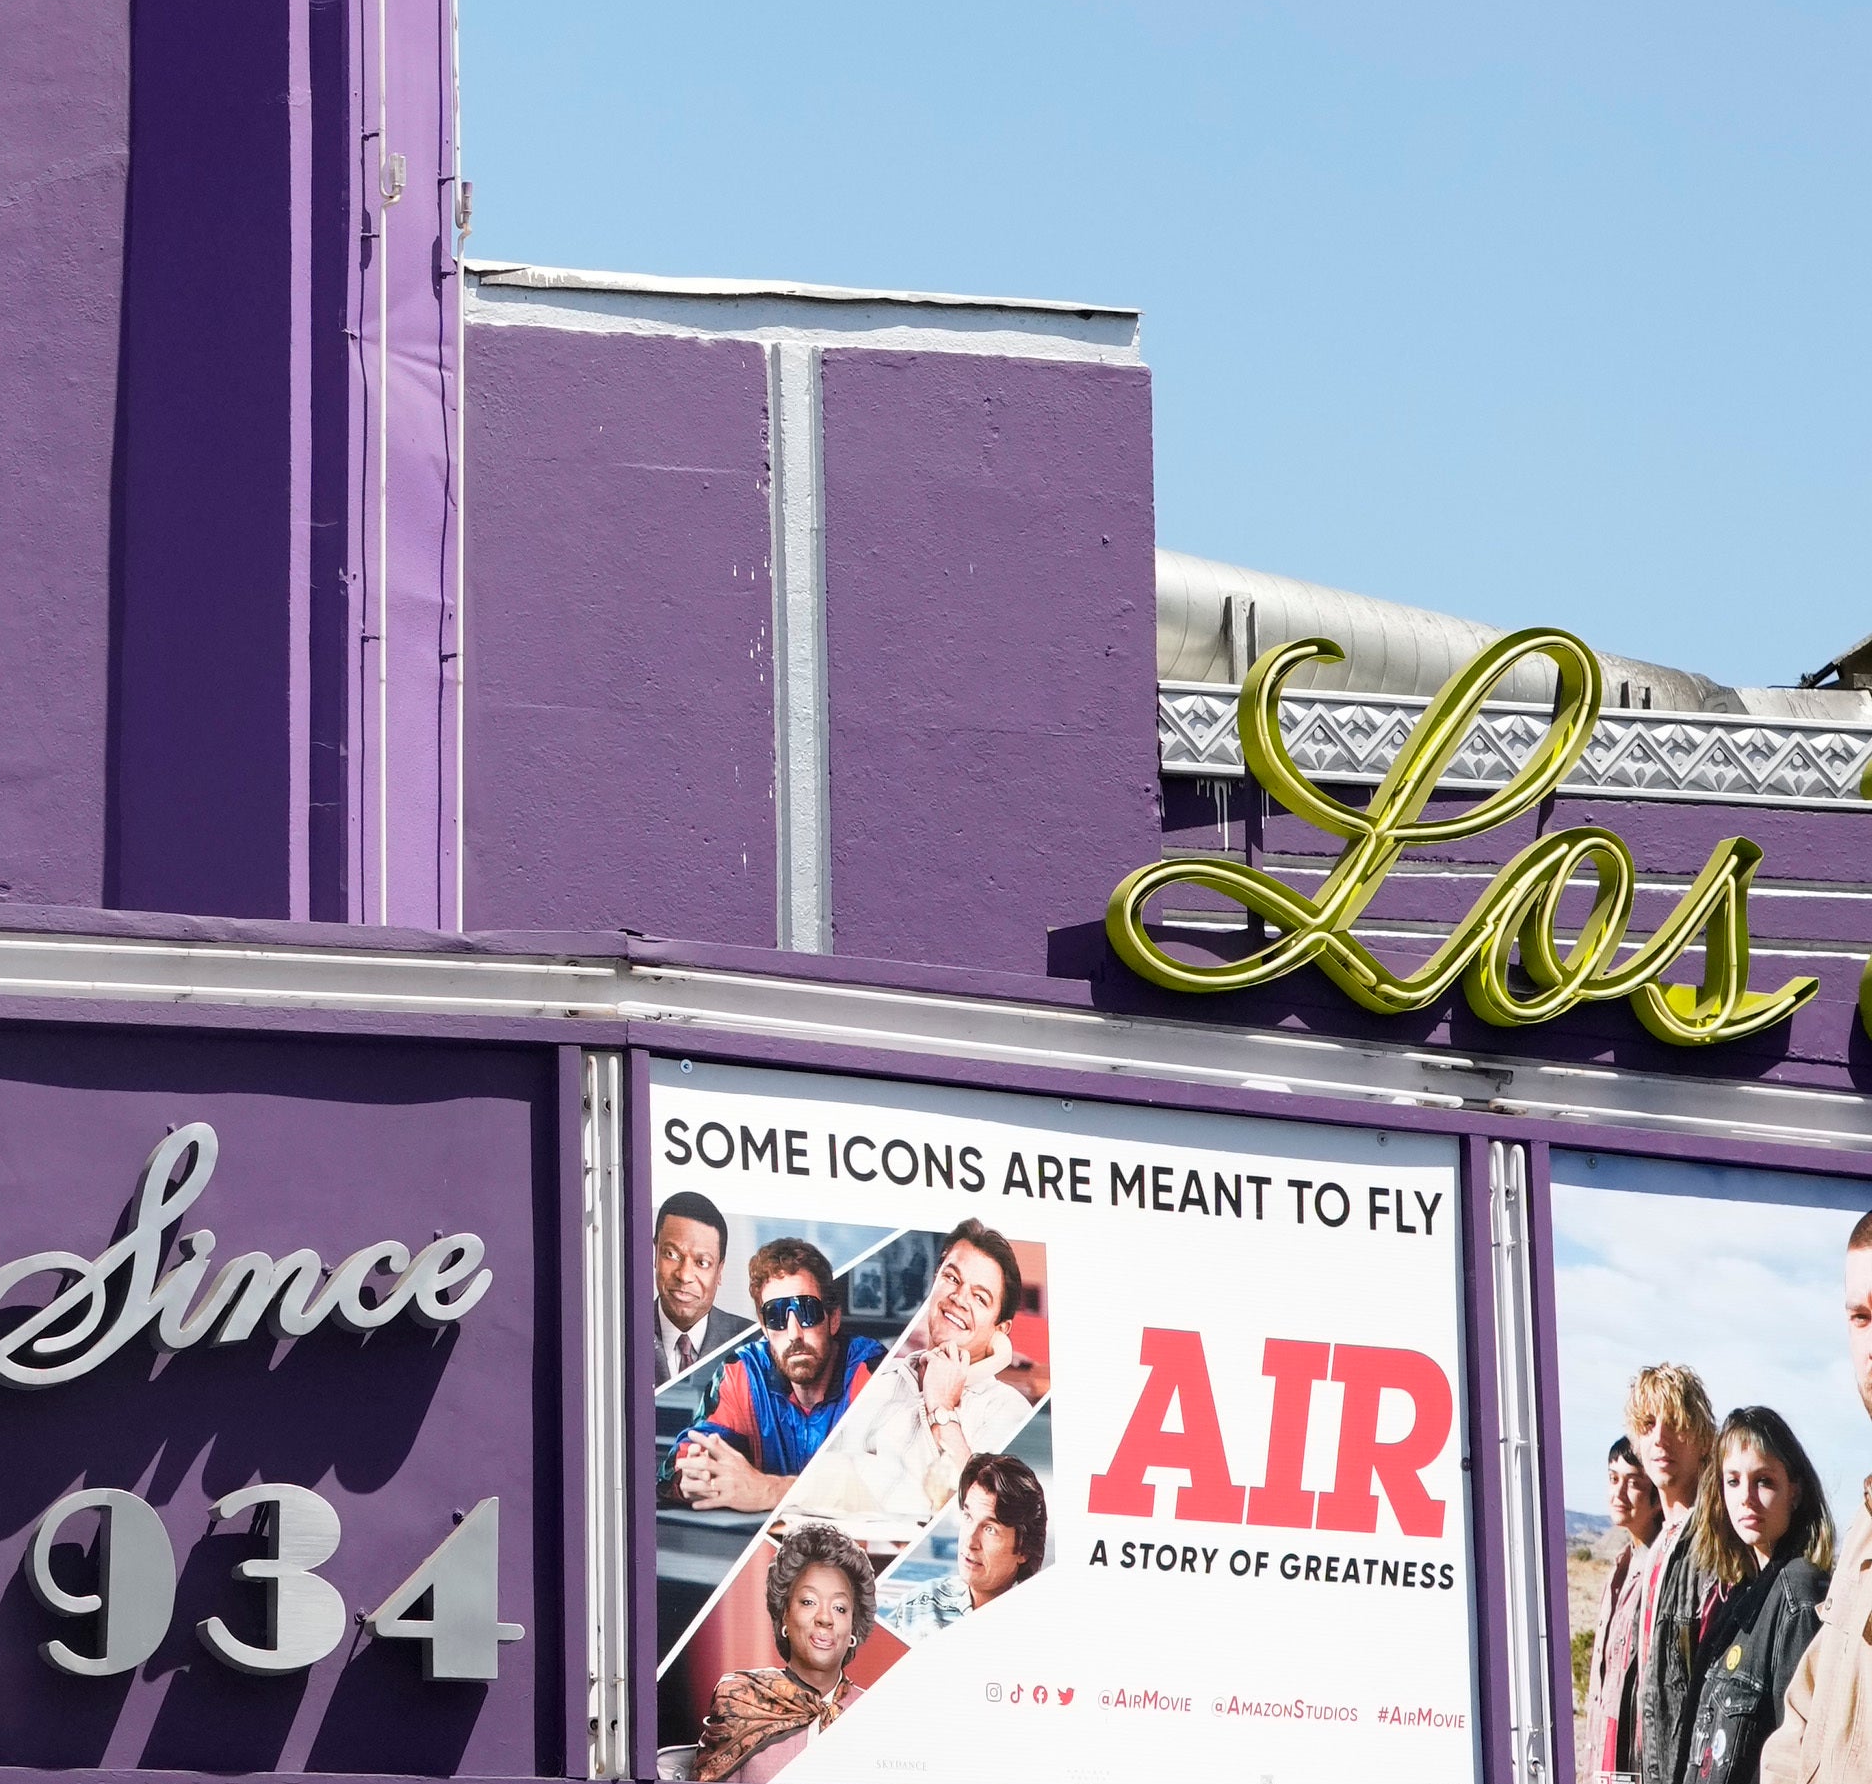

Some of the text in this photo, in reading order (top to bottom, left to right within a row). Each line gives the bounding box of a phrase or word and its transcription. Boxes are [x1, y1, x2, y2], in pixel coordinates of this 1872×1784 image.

[1105, 627, 1819, 1047] Los
[663, 1117, 1443, 1237] SOME ICONS ARE MEANT TO FLY
[1087, 1327, 1454, 1539] AIR
[1089, 1540, 1455, 1591] A STORY OF GREATNESS
